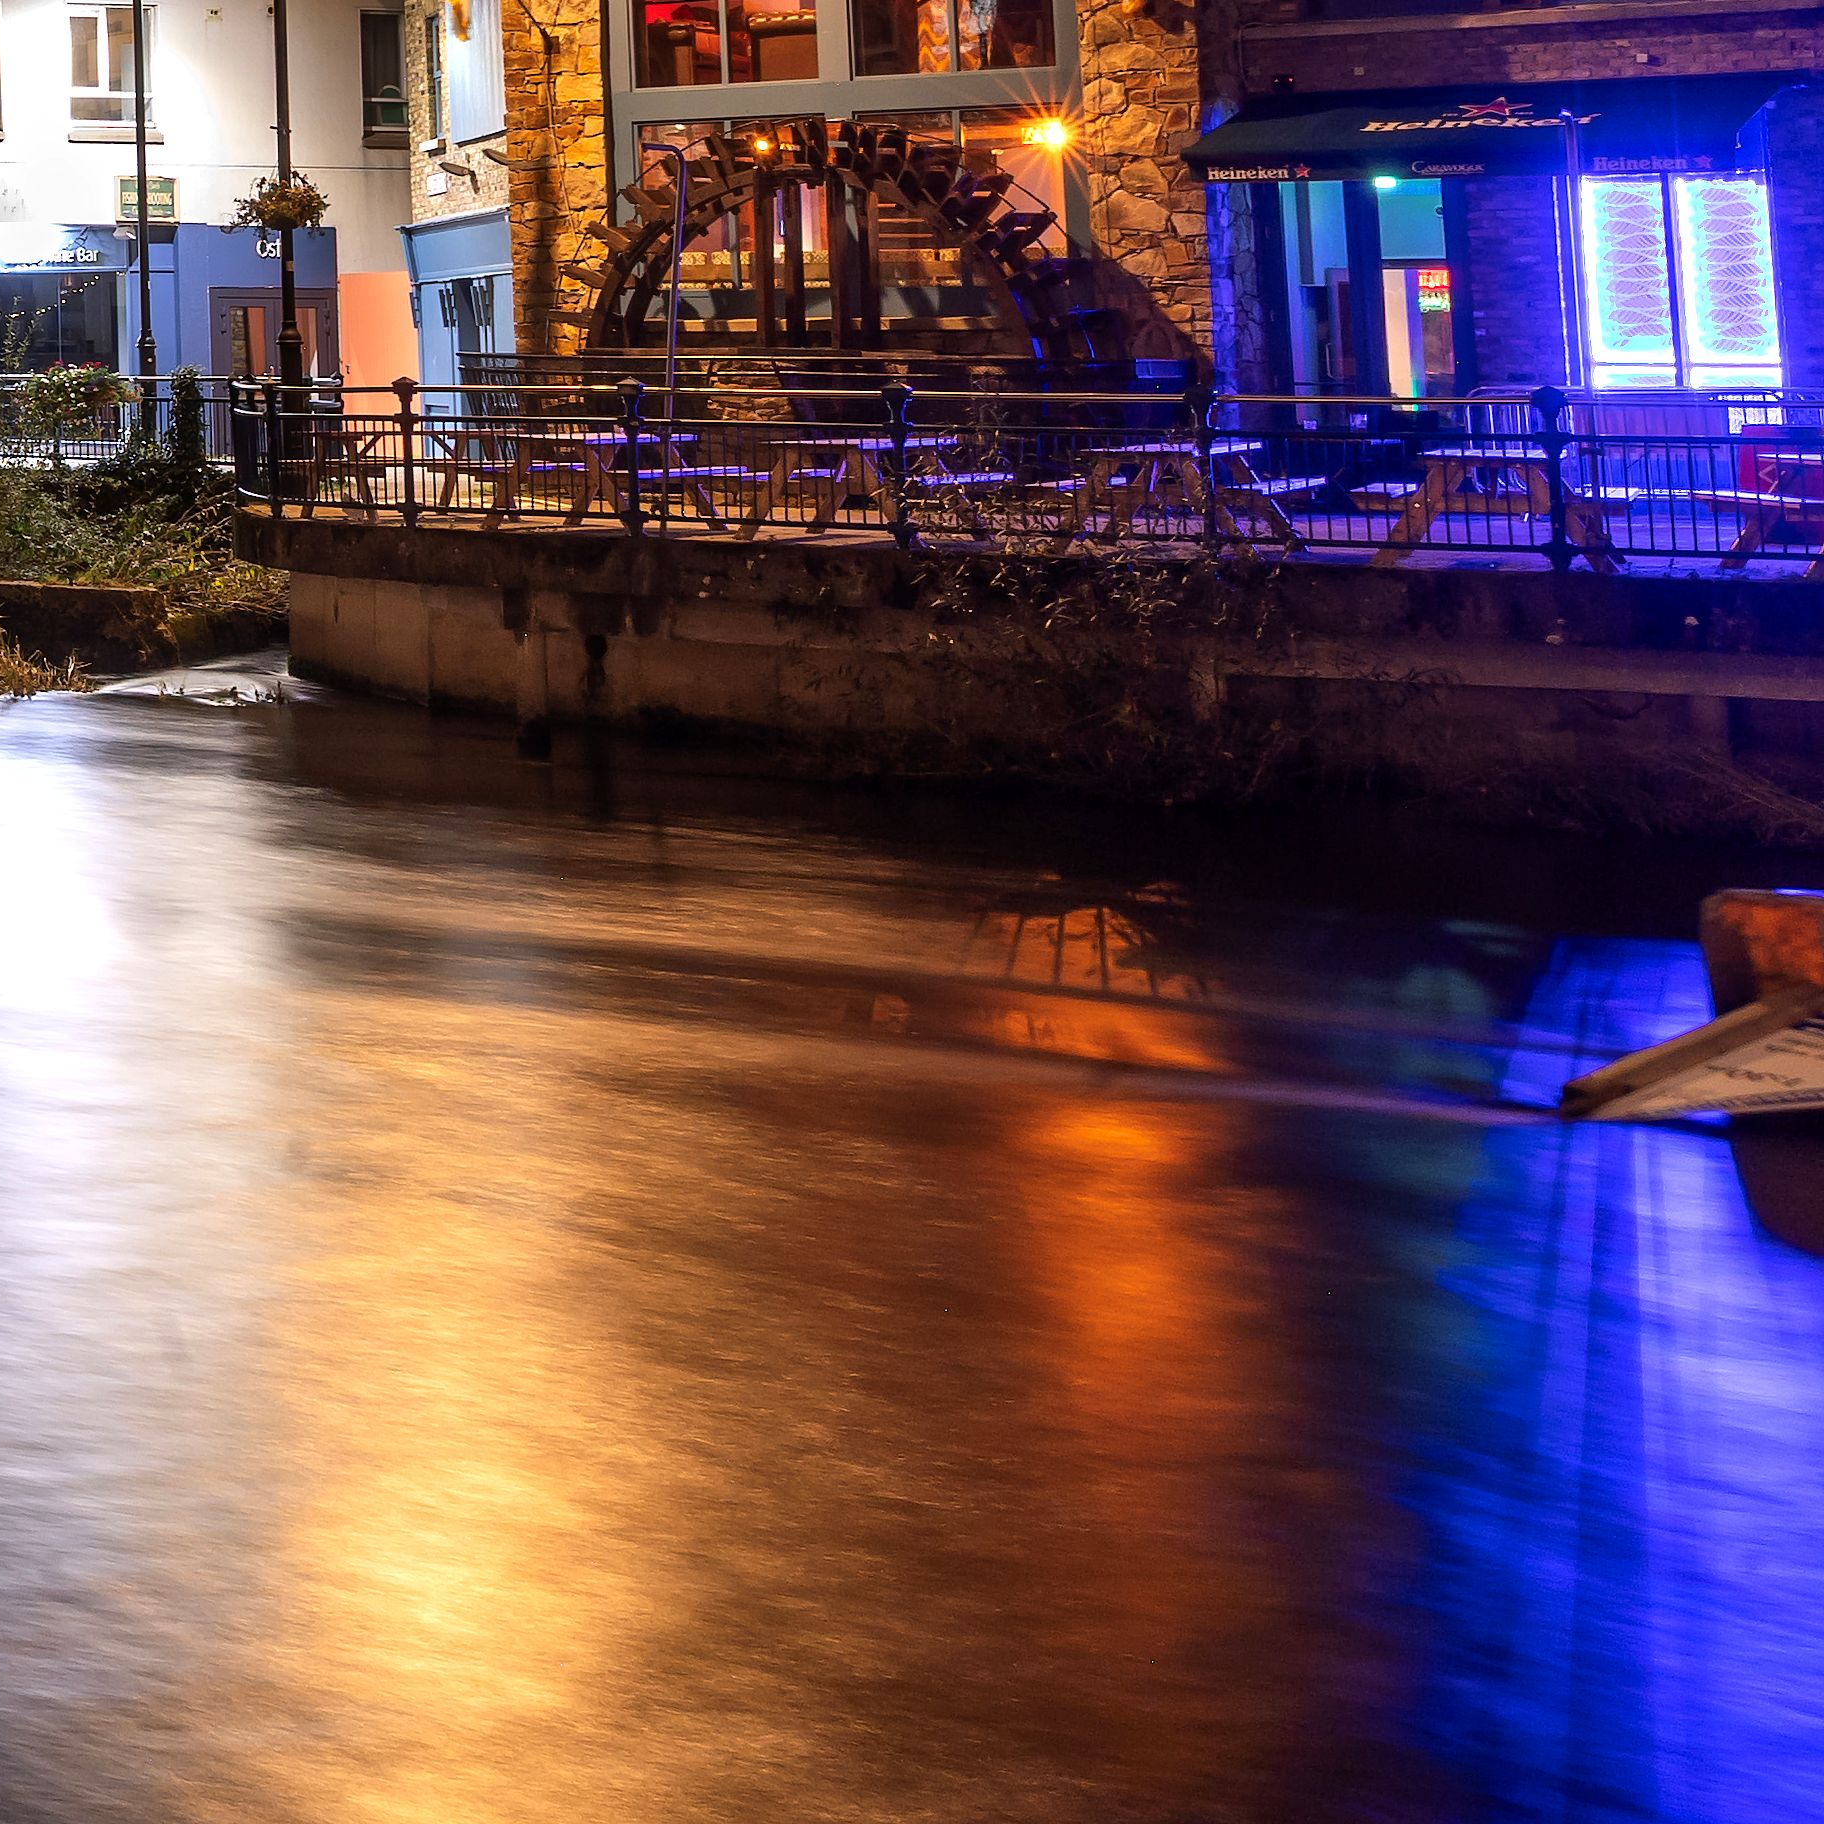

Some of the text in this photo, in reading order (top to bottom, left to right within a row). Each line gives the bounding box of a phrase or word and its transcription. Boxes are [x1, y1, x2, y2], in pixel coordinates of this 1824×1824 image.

[1592, 156, 1688, 171] Heineken
[1207, 166, 1289, 180] Heineken
[76, 246, 100, 263] Bar
